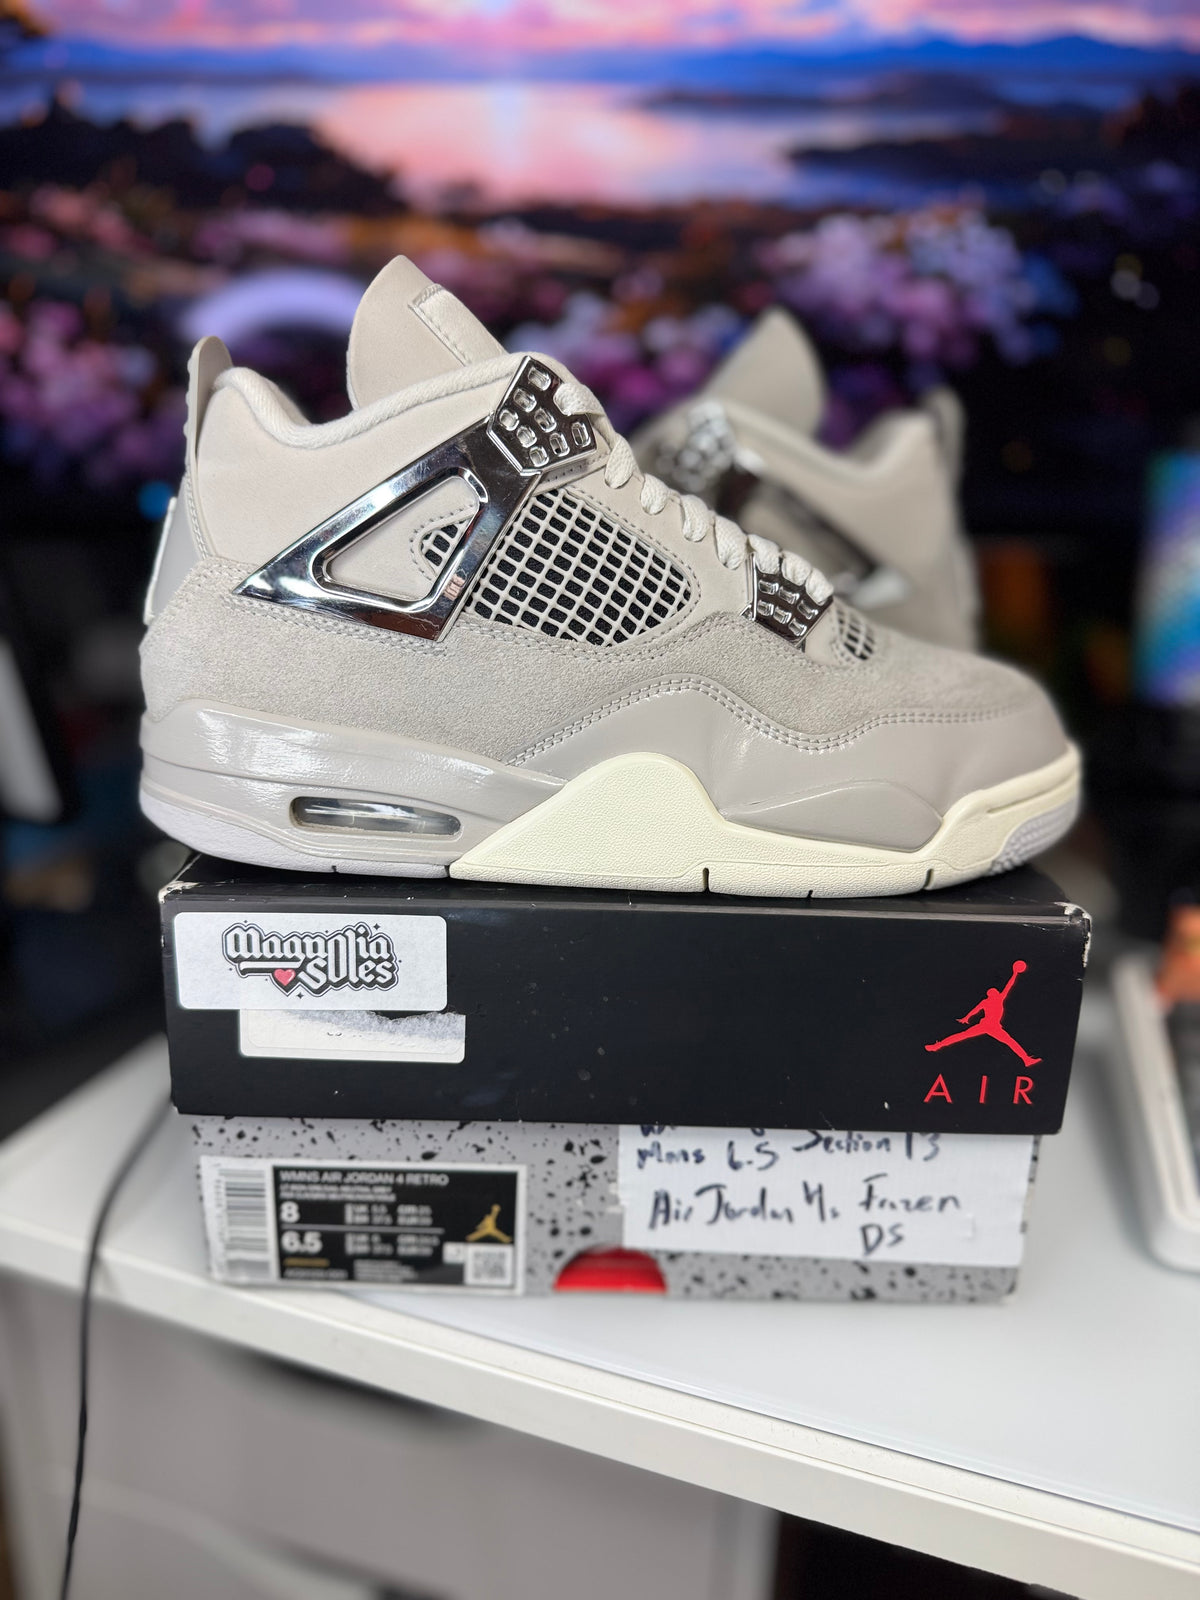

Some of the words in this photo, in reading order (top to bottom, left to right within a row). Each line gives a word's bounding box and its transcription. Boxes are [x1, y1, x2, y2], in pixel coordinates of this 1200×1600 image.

[222, 923, 394, 970] Magnolia
[923, 1073, 1034, 1104] AIR
[728, 1140, 779, 1171] 6.5
[792, 1130, 891, 1153] Section
[905, 1131, 941, 1162] 13
[279, 1171, 319, 1183] WMNS
[320, 1172, 342, 1184] AIR
[343, 1172, 394, 1185] JORDAN
[395, 1173, 404, 1185] 4
[405, 1173, 450, 1187] RETRO
[280, 1201, 300, 1223] 8
[648, 1189, 693, 1230] Air
[694, 1184, 794, 1226] Jordan
[281, 1230, 323, 1254] 6.5
[859, 1222, 904, 1257] DS
